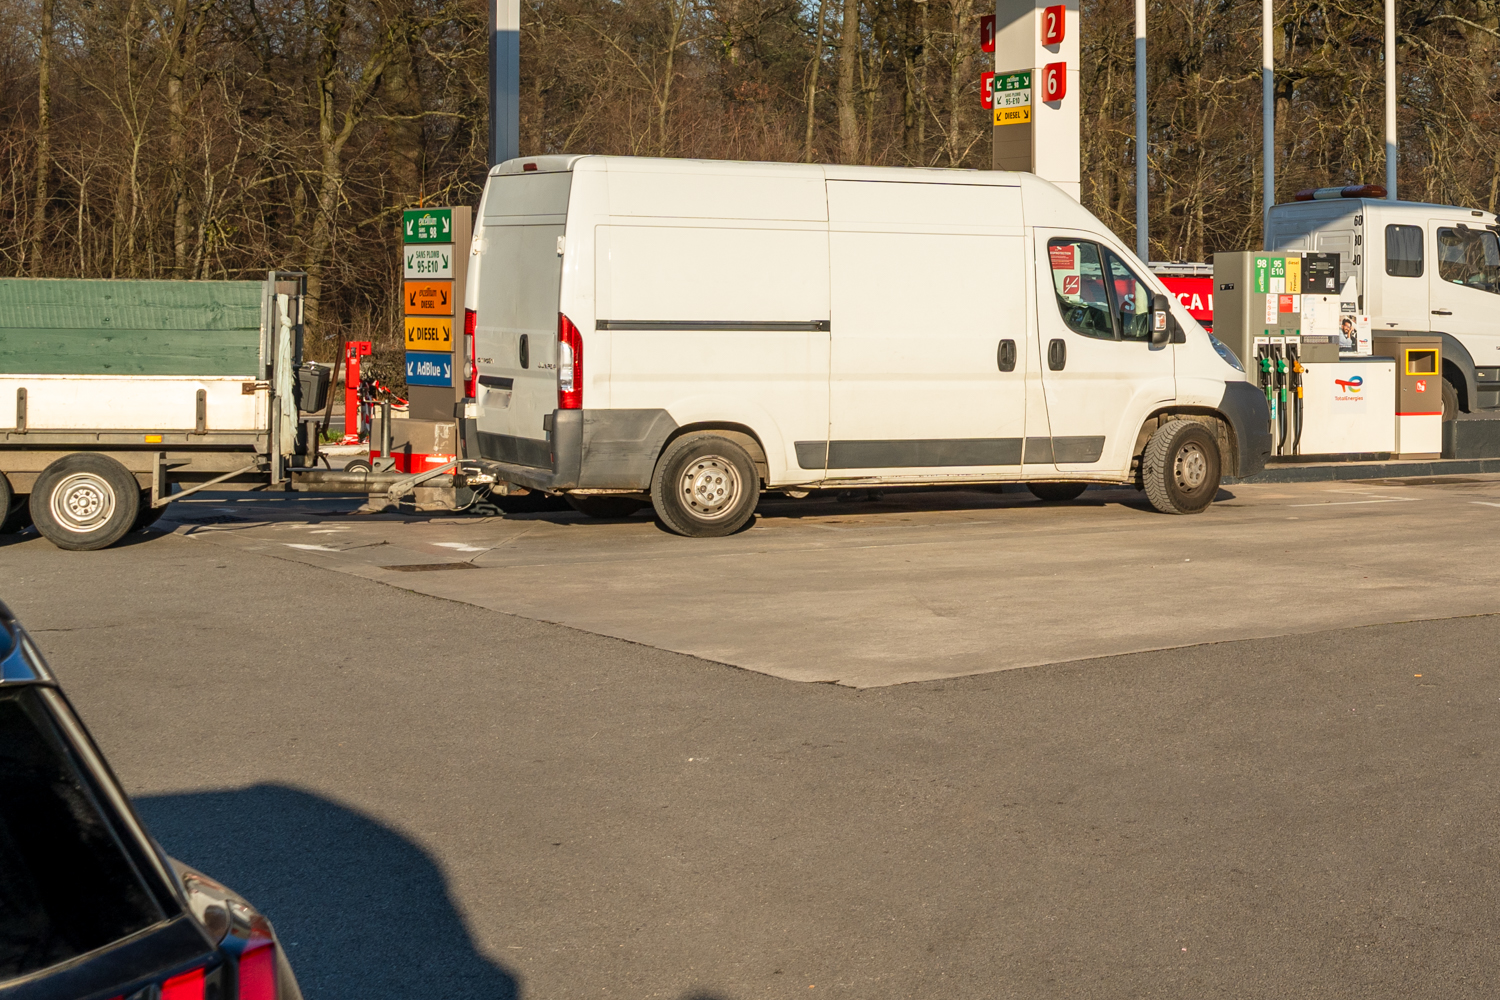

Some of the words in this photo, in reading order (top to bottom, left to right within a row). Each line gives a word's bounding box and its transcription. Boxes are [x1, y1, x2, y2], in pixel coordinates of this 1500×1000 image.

[1047, 12, 1057, 38] 2
[986, 22, 993, 46] 1
[1047, 69, 1057, 95] 6
[985, 77, 994, 102] 5
[1005, 111, 1020, 119] DIESEL
[429, 227, 437, 239] 98
[416, 250, 426, 259] SANS
[427, 250, 440, 259] PLOMB
[417, 260, 439, 273] 95-E10
[1257, 259, 1267, 268] 98
[1273, 260, 1282, 268] 95
[1271, 268, 1284, 276] E10
[421, 300, 435, 309] DIESEL
[416, 327, 440, 341] DIESEL
[416, 361, 442, 377] AdBlue
